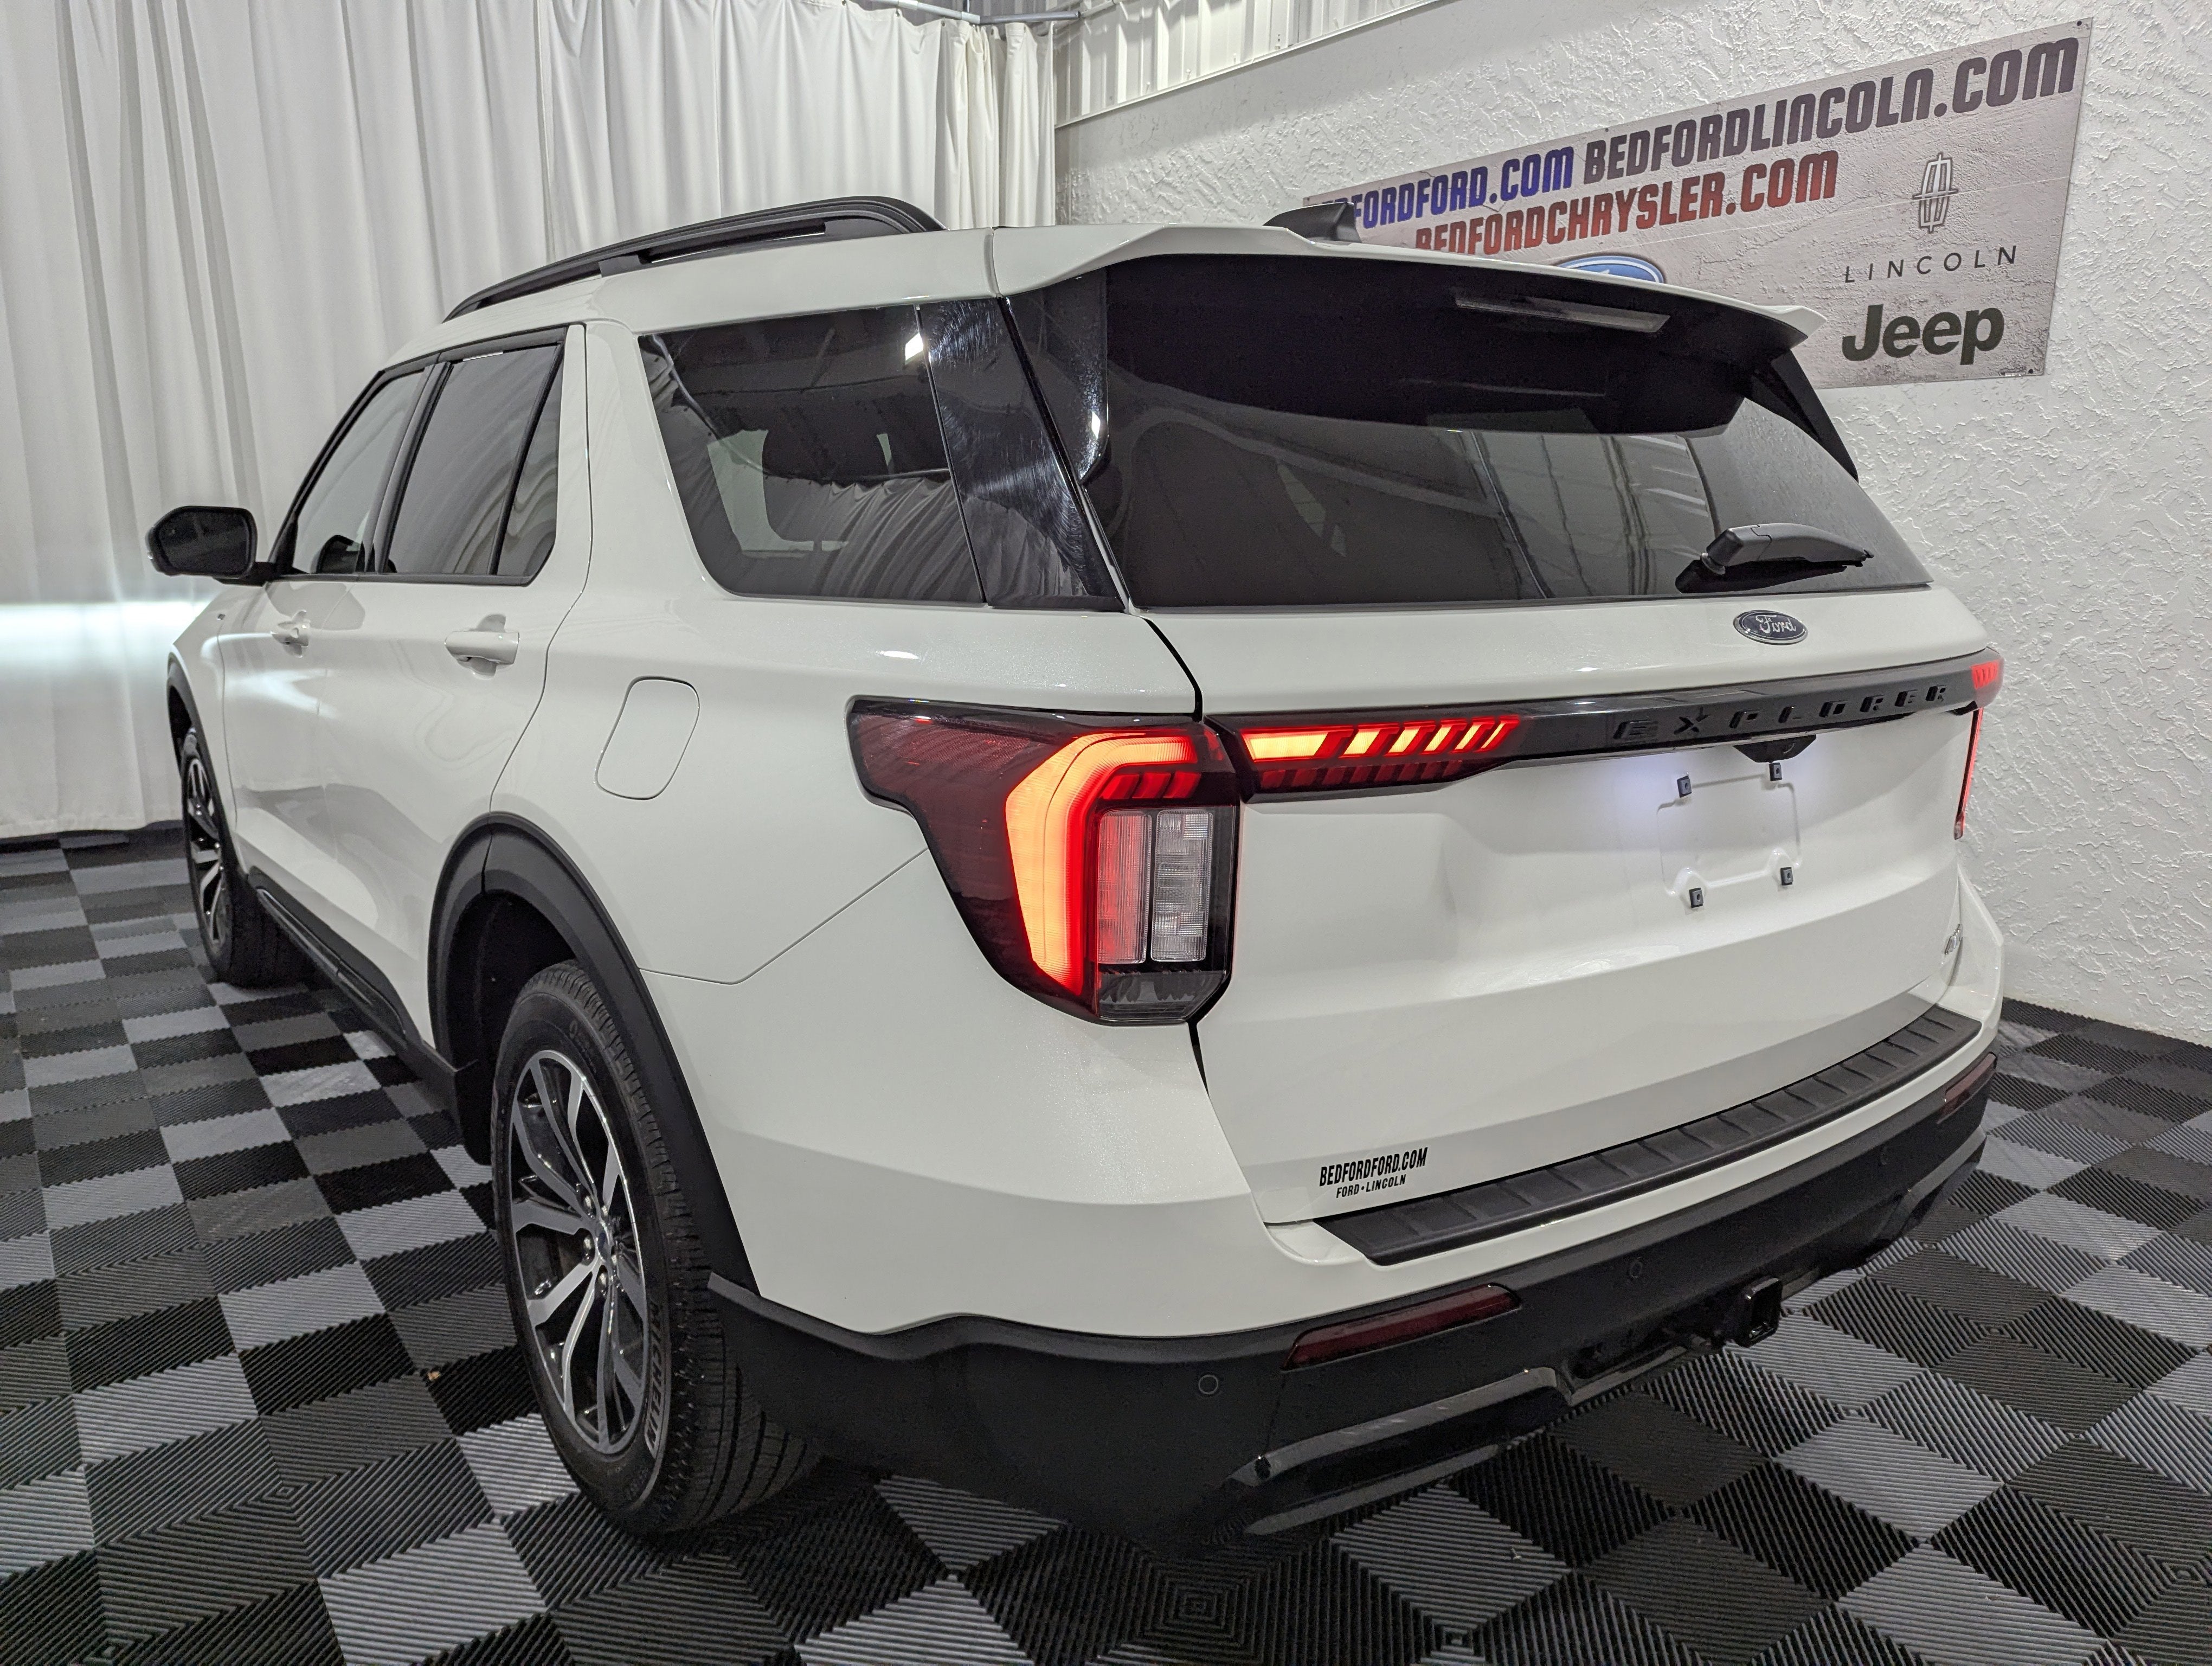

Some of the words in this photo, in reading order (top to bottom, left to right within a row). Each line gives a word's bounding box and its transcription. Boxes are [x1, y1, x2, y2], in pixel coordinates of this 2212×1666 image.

[1314, 145, 1574, 229] FORDFORD.COM
[1583, 37, 2079, 185] BEDFORDLINCOLN.COM
[1844, 245, 2017, 284] LINCOLN
[1842, 304, 2005, 366] Jeep
[1755, 614, 1797, 634] Ford
[1612, 684, 1948, 740] EXPLORER
[1319, 1146, 1429, 1187] BEDFORDFORD.COM
[647, 1302, 662, 1450] MICHELIN
